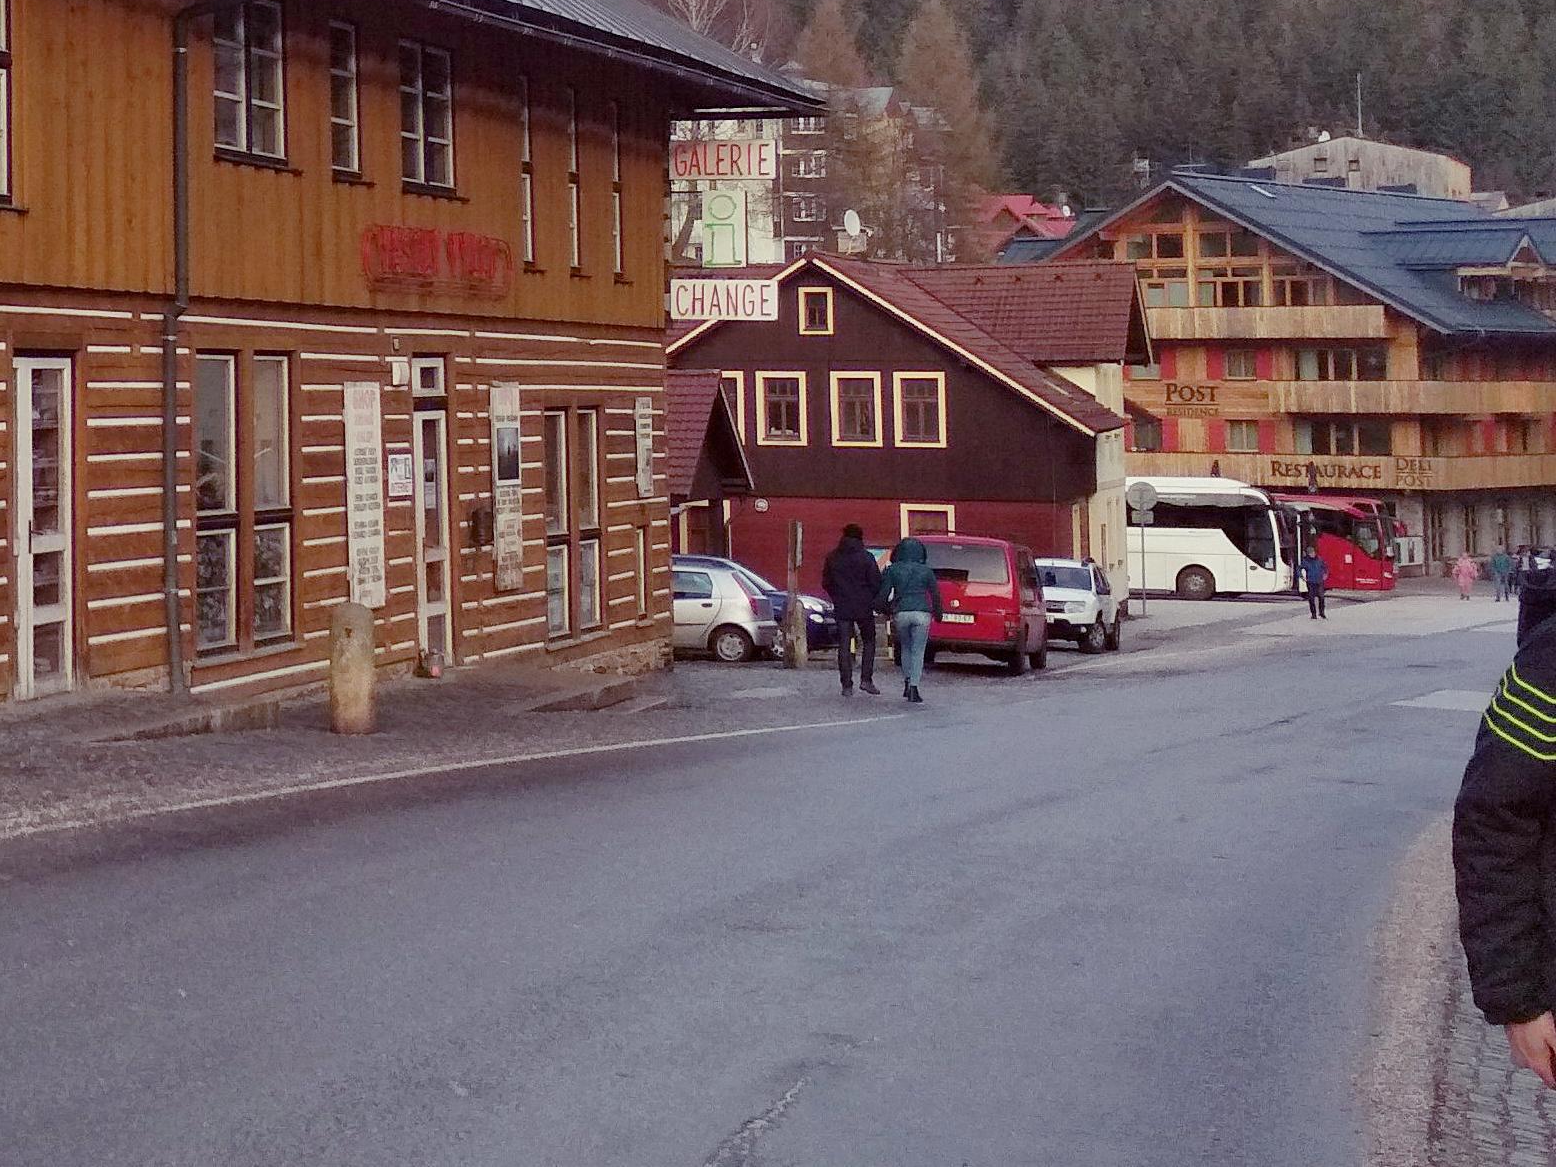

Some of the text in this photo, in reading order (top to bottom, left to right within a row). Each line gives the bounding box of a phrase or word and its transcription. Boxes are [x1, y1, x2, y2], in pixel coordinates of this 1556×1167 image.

[674, 143, 770, 177] GALERIE
[675, 284, 772, 317] CHANGE
[1164, 383, 1220, 402] POST
[1271, 460, 1382, 479] RESTAURACE
